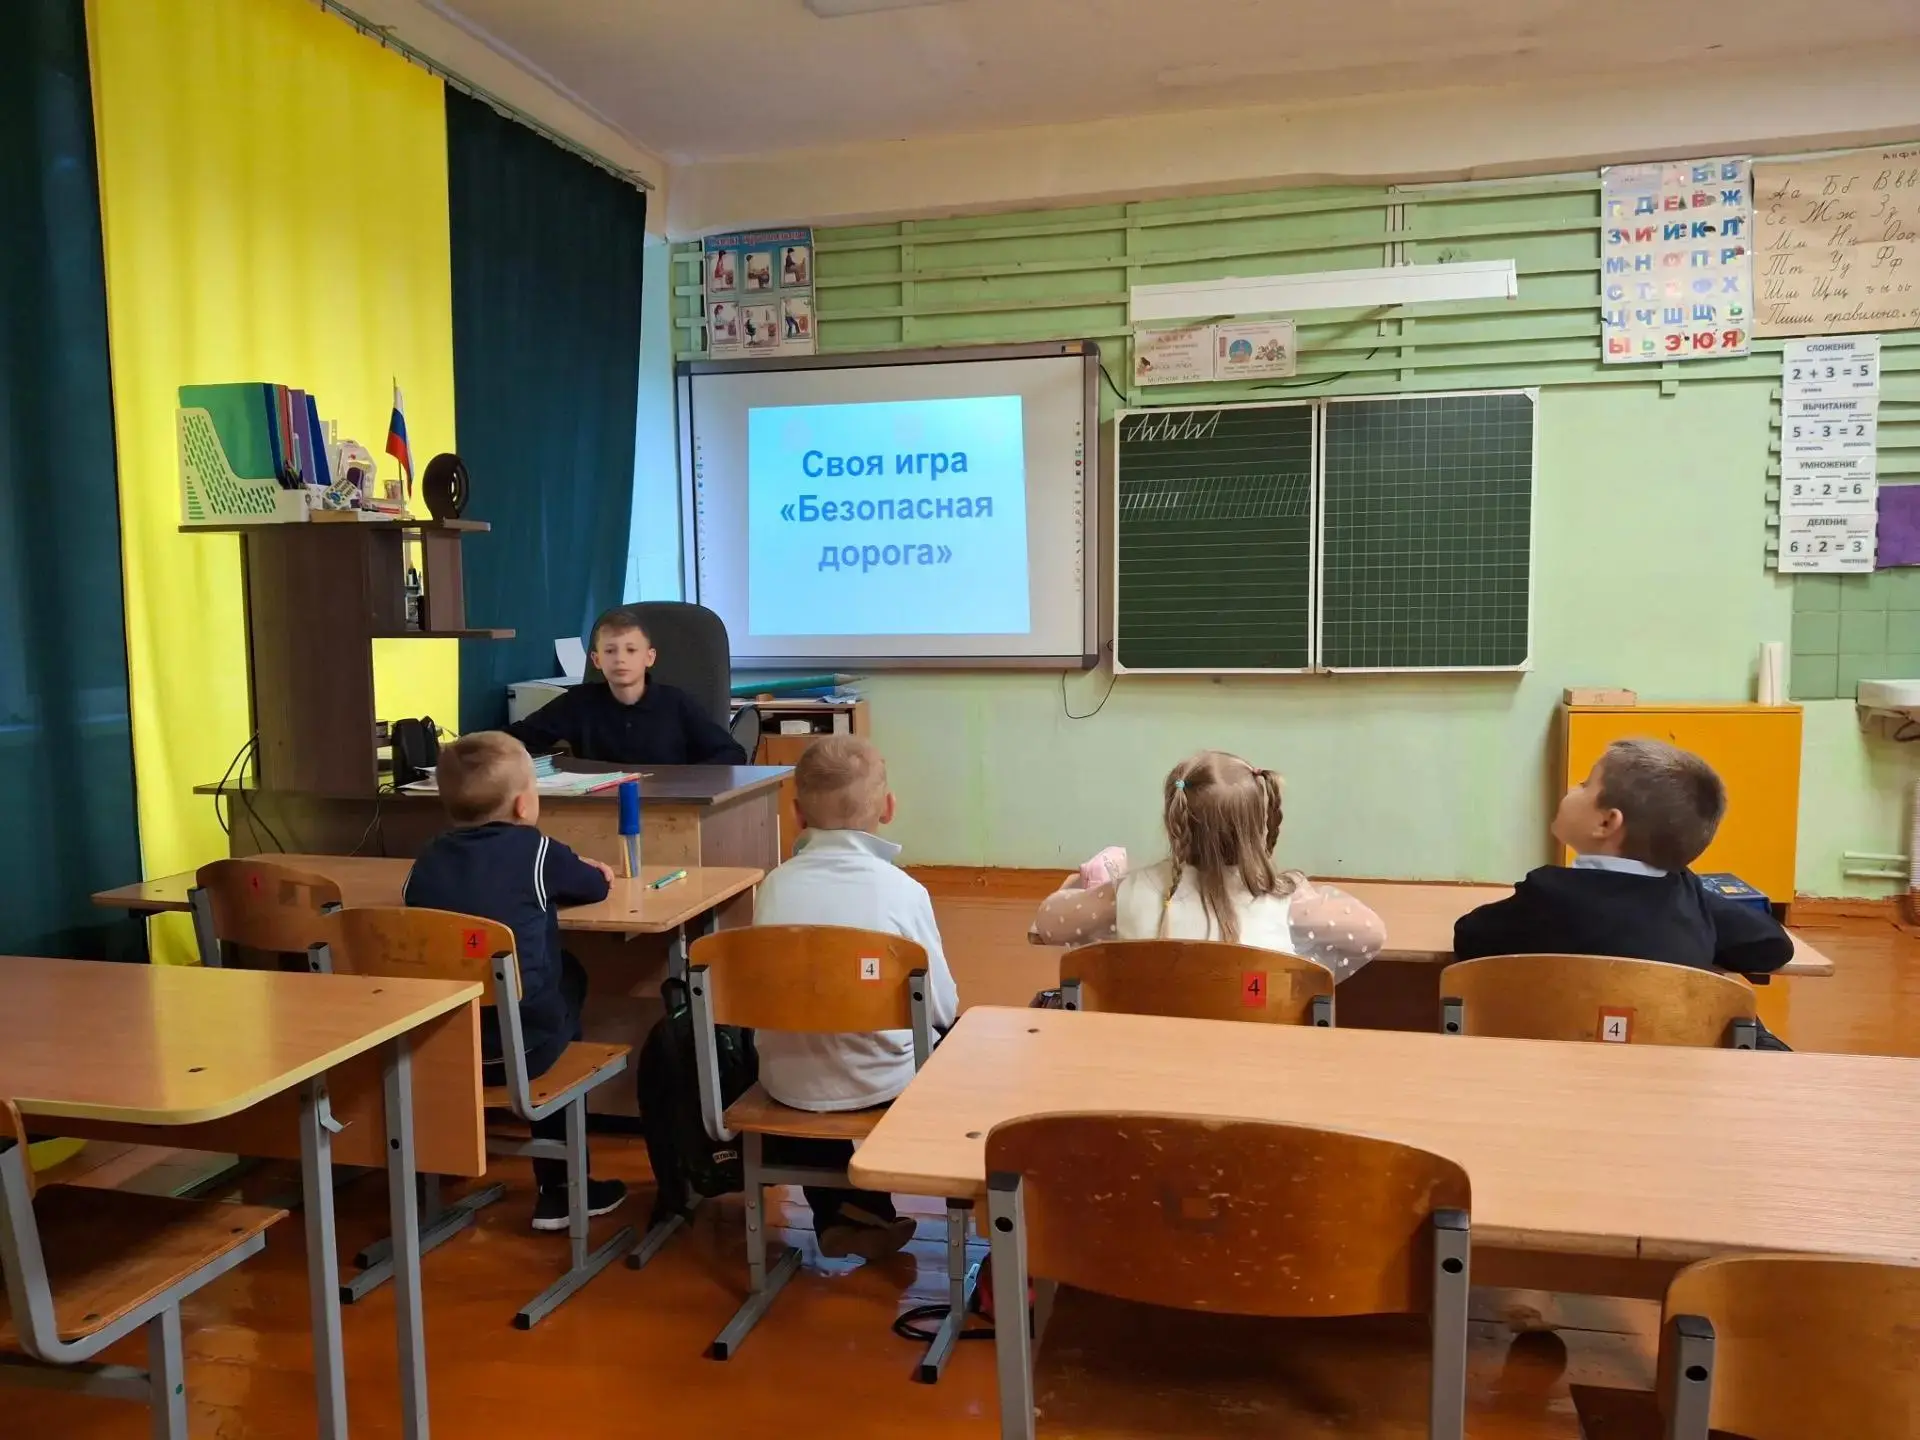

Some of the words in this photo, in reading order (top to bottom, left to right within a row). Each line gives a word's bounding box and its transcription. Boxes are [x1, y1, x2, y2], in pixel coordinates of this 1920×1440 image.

[1721, 163, 1738, 181] В
[1635, 196, 1654, 216] Д
[1664, 196, 1678, 212] Е
[1721, 189, 1742, 206] Ж
[1608, 228, 1621, 245] З
[1635, 227, 1652, 242] И
[1692, 221, 1707, 238] К
[1720, 219, 1739, 236] Л
[1607, 257, 1624, 273] М
[1635, 254, 1652, 271] Н
[1692, 250, 1709, 267] П
[1721, 249, 1736, 265] Р
[1722, 276, 1738, 293] Х
[1636, 309, 1652, 325] Ч
[1664, 308, 1682, 324] Ш
[1693, 304, 1712, 321] Щ
[1609, 336, 1631, 354] Ы
[1665, 335, 1681, 351] Э
[1693, 332, 1715, 350] Ю
[1722, 331, 1738, 348] Я
[1807, 343, 1856, 352] СЛОЖЕНИЕ
[1792, 368, 1802, 380] 2
[1826, 366, 1835, 378] 3
[1860, 364, 1869, 376] 5
[1803, 402, 1857, 411] ВЫЧИТАНИЕ
[1792, 426, 1801, 438] 5
[1822, 425, 1831, 437] 3
[1856, 424, 1865, 436] 2
[802, 450, 883, 477] Своя
[895, 451, 968, 481] игра
[1800, 461, 1857, 469] УМНОЖЕНИЕ
[1793, 484, 1802, 496] 3
[1822, 483, 1832, 495] 2
[1853, 483, 1862, 495] 6
[780, 494, 993, 522] «Безопасная
[1807, 518, 1848, 527] ДЕЛЕНИЕ
[1790, 541, 1799, 553] 6
[1818, 541, 1828, 553] 2
[1852, 540, 1862, 552] 3
[818, 543, 953, 574] дорога»
[467, 932, 480, 948] 4
[865, 963, 875, 976] 4
[1248, 978, 1261, 996] 4
[1608, 1021, 1621, 1037] 4
